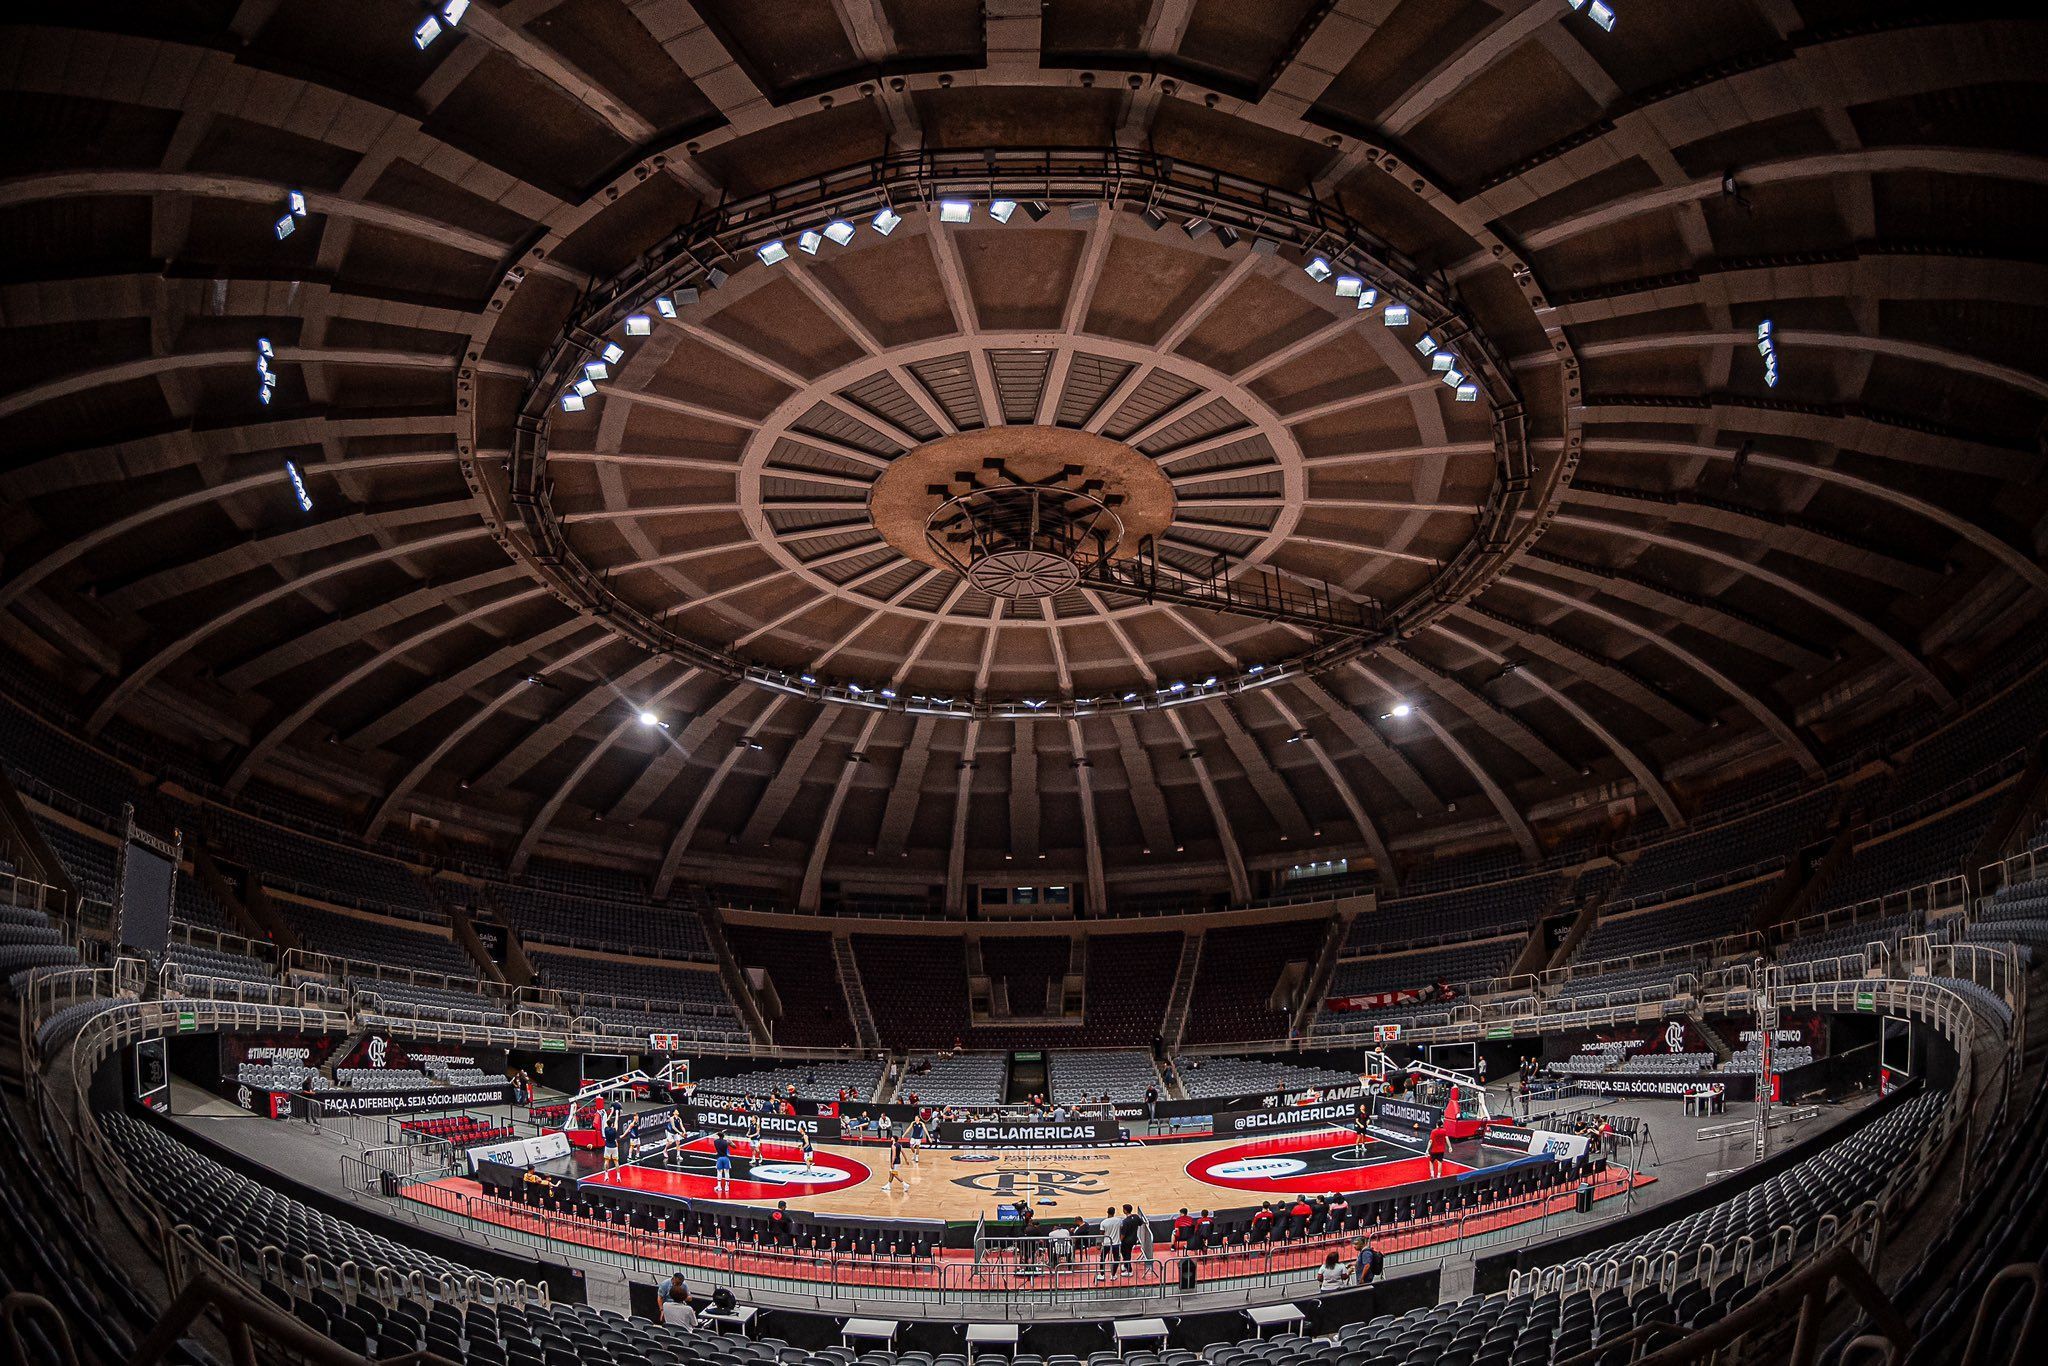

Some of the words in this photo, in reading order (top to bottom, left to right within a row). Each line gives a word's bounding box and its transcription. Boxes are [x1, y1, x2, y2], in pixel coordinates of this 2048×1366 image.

[248, 1047, 310, 1060] #TIMEFLAMENGO
[1581, 1041, 1623, 1051] JOGAREMOS
[1612, 1081, 1631, 1091] SEJA
[1631, 1079, 1657, 1093] SÓCIO:
[324, 1098, 349, 1112] FAÇA
[350, 1098, 357, 1109] A
[358, 1097, 407, 1110] DIFERENÇA.
[408, 1096, 427, 1107] SEJA
[427, 1093, 451, 1106] SÓCIO:
[452, 1091, 503, 1104] MENGO.COM.BR
[1235, 1104, 1355, 1130] @BCLAMERICAS
[1382, 1103, 1431, 1124] @BCLAMERICAS
[963, 1125, 1095, 1141] @BCLAMERICAS
[1550, 1141, 1570, 1157] BRB
